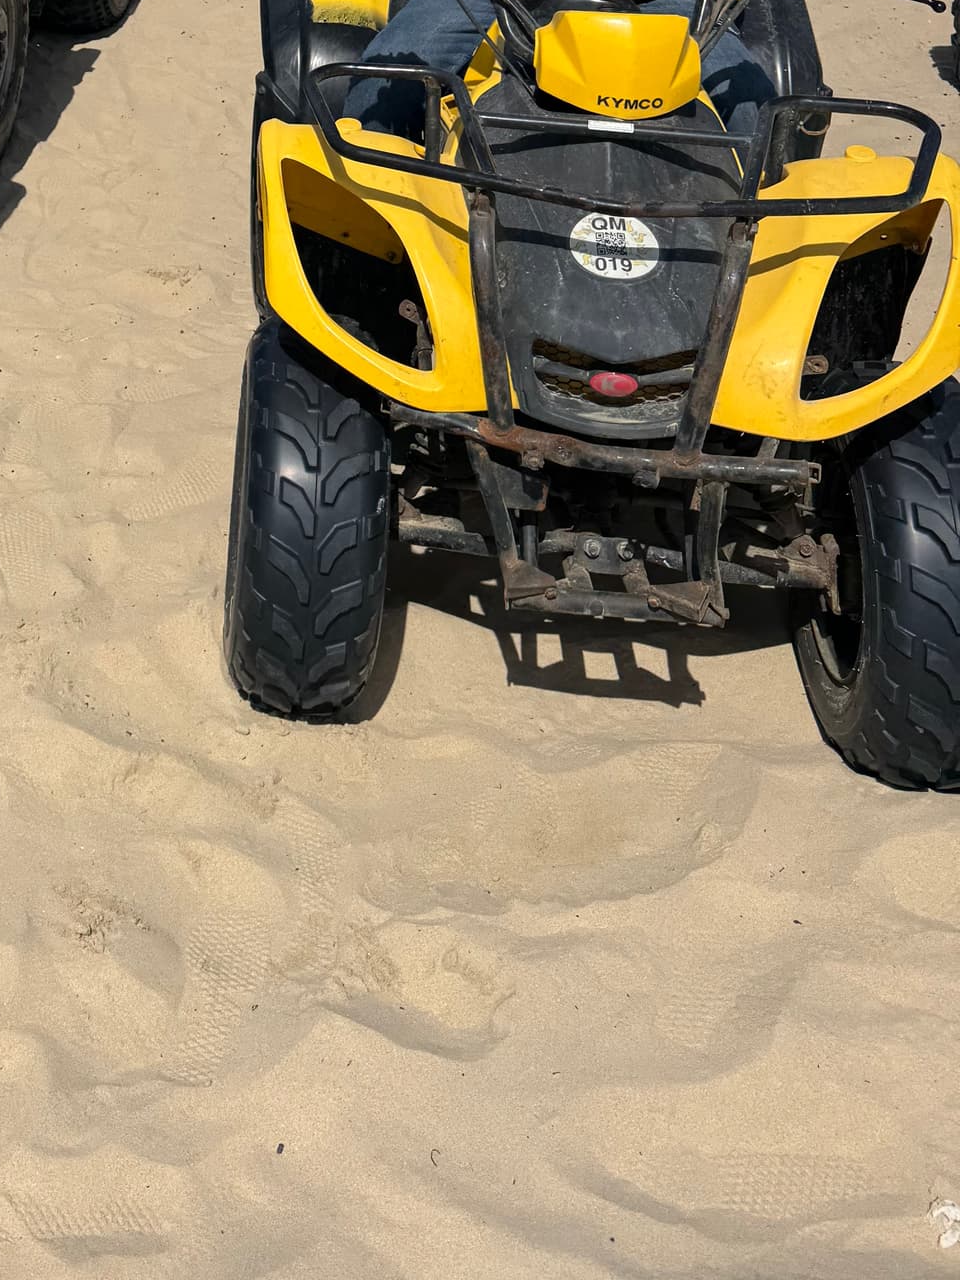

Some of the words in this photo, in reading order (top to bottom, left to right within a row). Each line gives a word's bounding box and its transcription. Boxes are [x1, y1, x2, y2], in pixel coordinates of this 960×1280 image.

[597, 95, 664, 110] KYMCO
[591, 216, 627, 231] QM
[595, 257, 633, 272] 019
